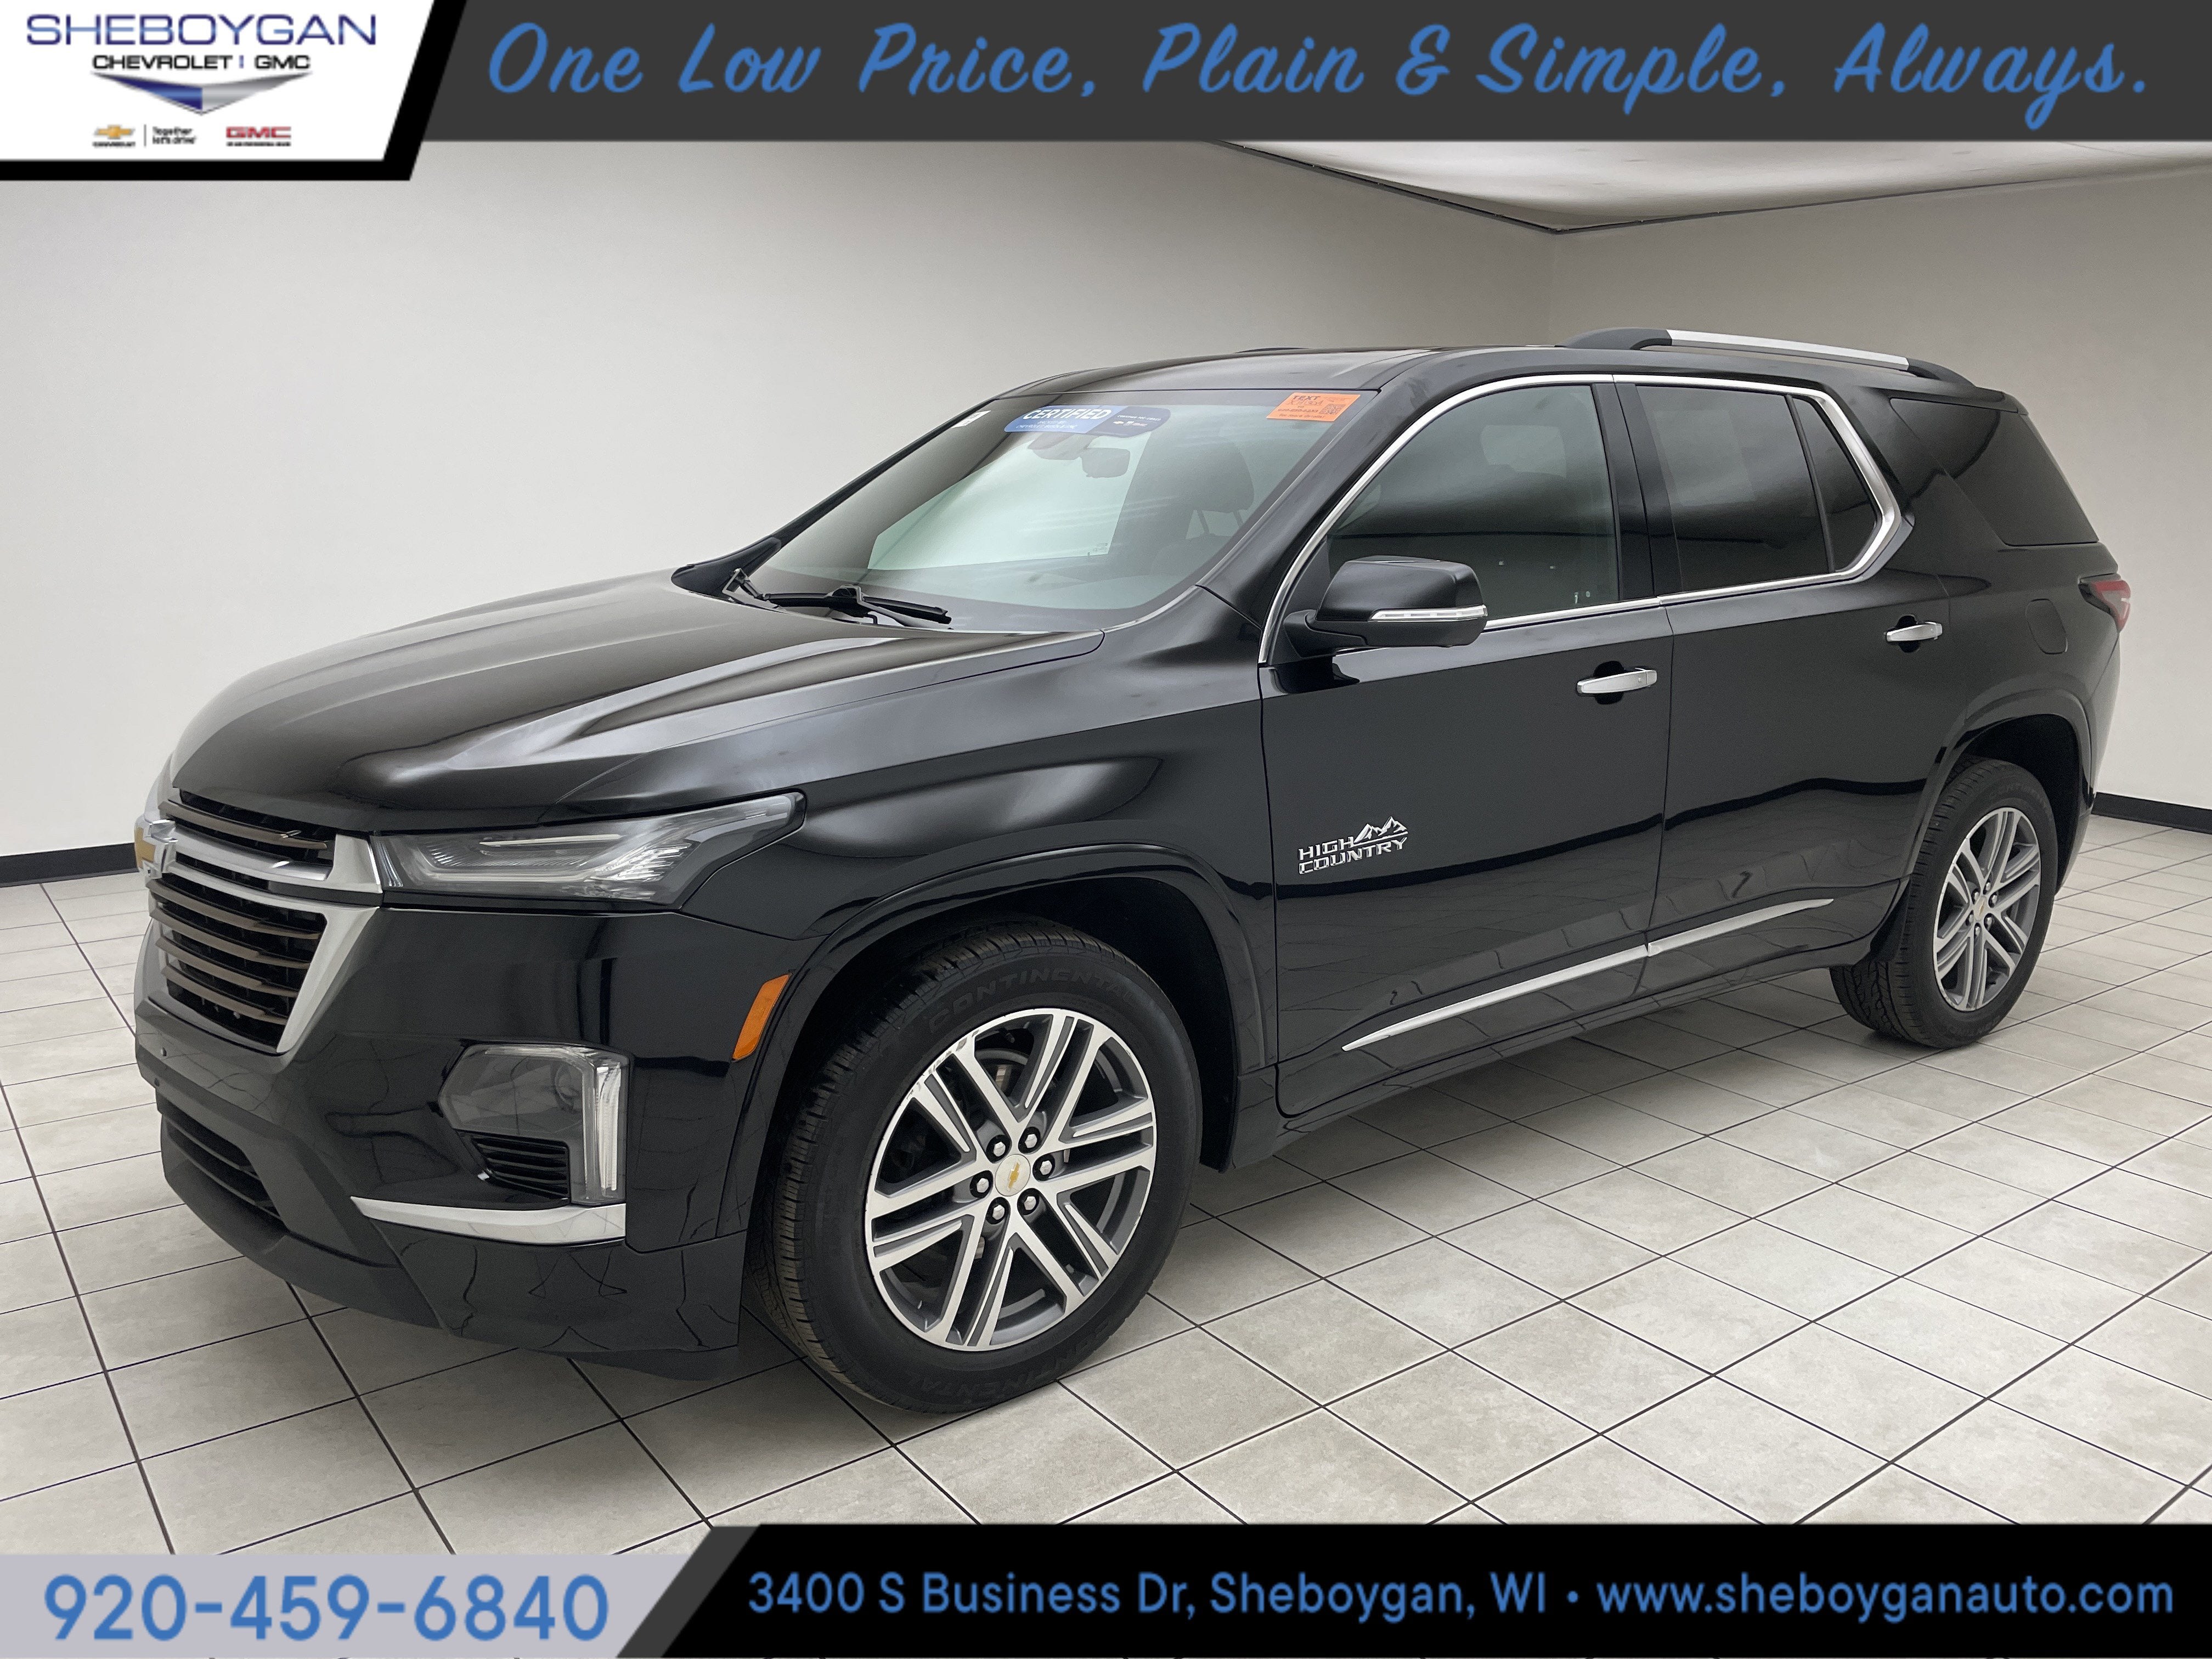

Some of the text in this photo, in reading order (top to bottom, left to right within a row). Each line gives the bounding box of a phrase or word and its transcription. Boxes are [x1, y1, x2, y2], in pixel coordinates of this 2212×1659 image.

[1023, 409, 1112, 420] CERTIFIED
[1298, 836, 1354, 861] HIGH
[1298, 837, 1408, 874] COUNTRY
[928, 967, 1137, 1034] CONTINENTAL
